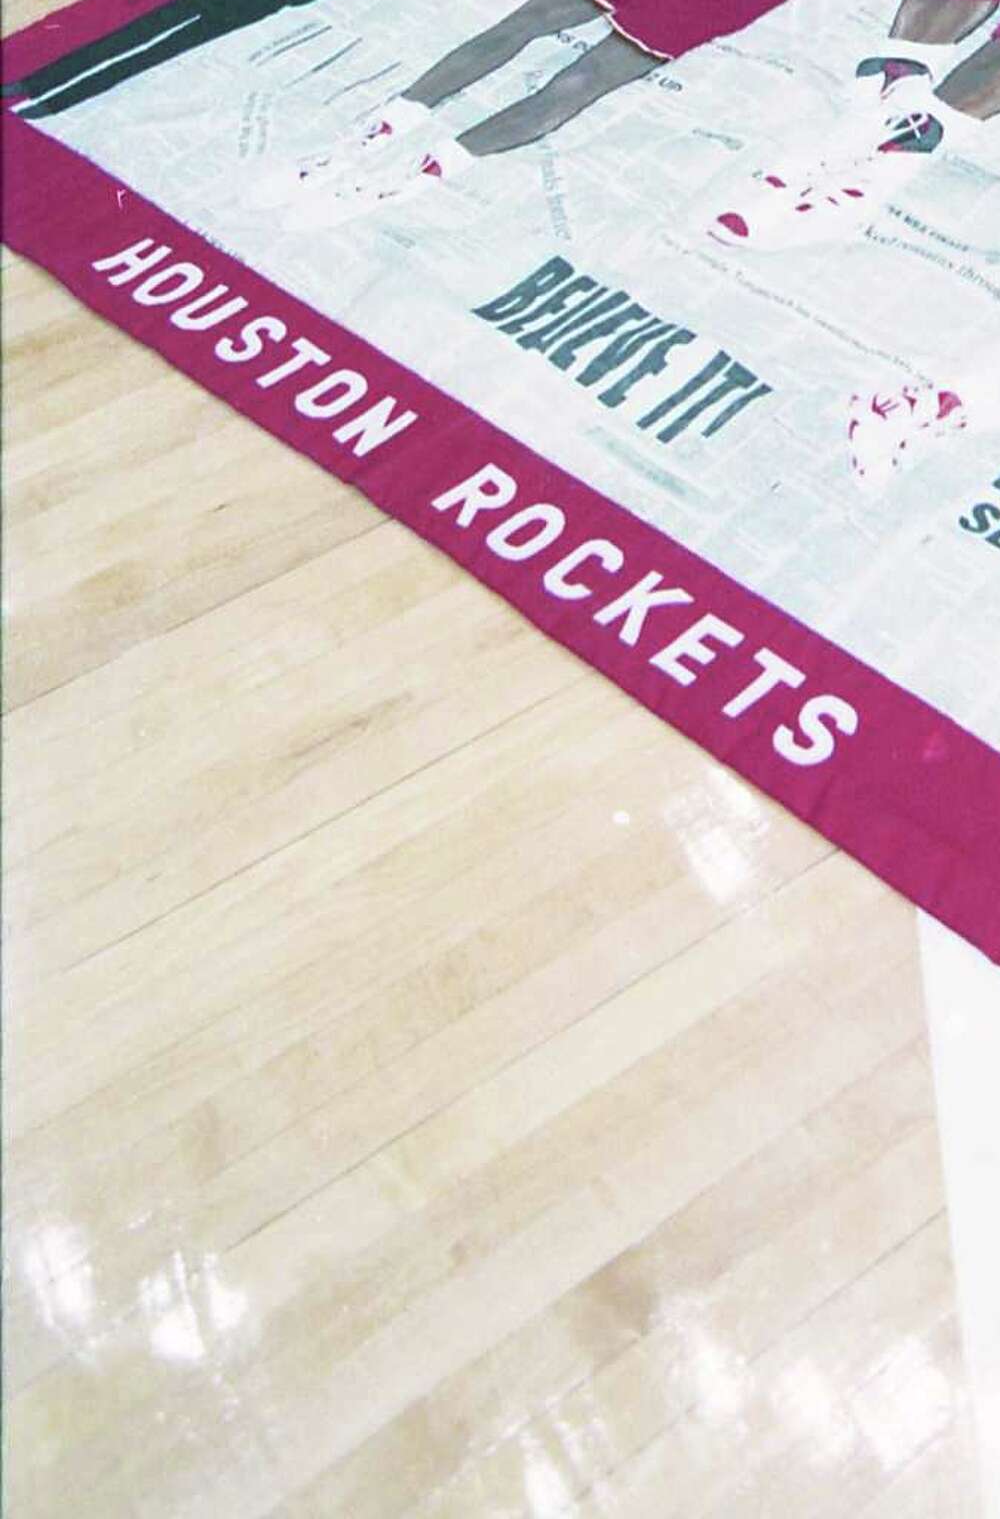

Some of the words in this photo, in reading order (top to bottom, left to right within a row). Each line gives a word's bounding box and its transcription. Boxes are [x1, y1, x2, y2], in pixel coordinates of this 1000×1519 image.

[472, 255, 697, 408] BELIEVE
[92, 238, 419, 458] HOUSTON
[431, 462, 859, 766] ROCKETS
